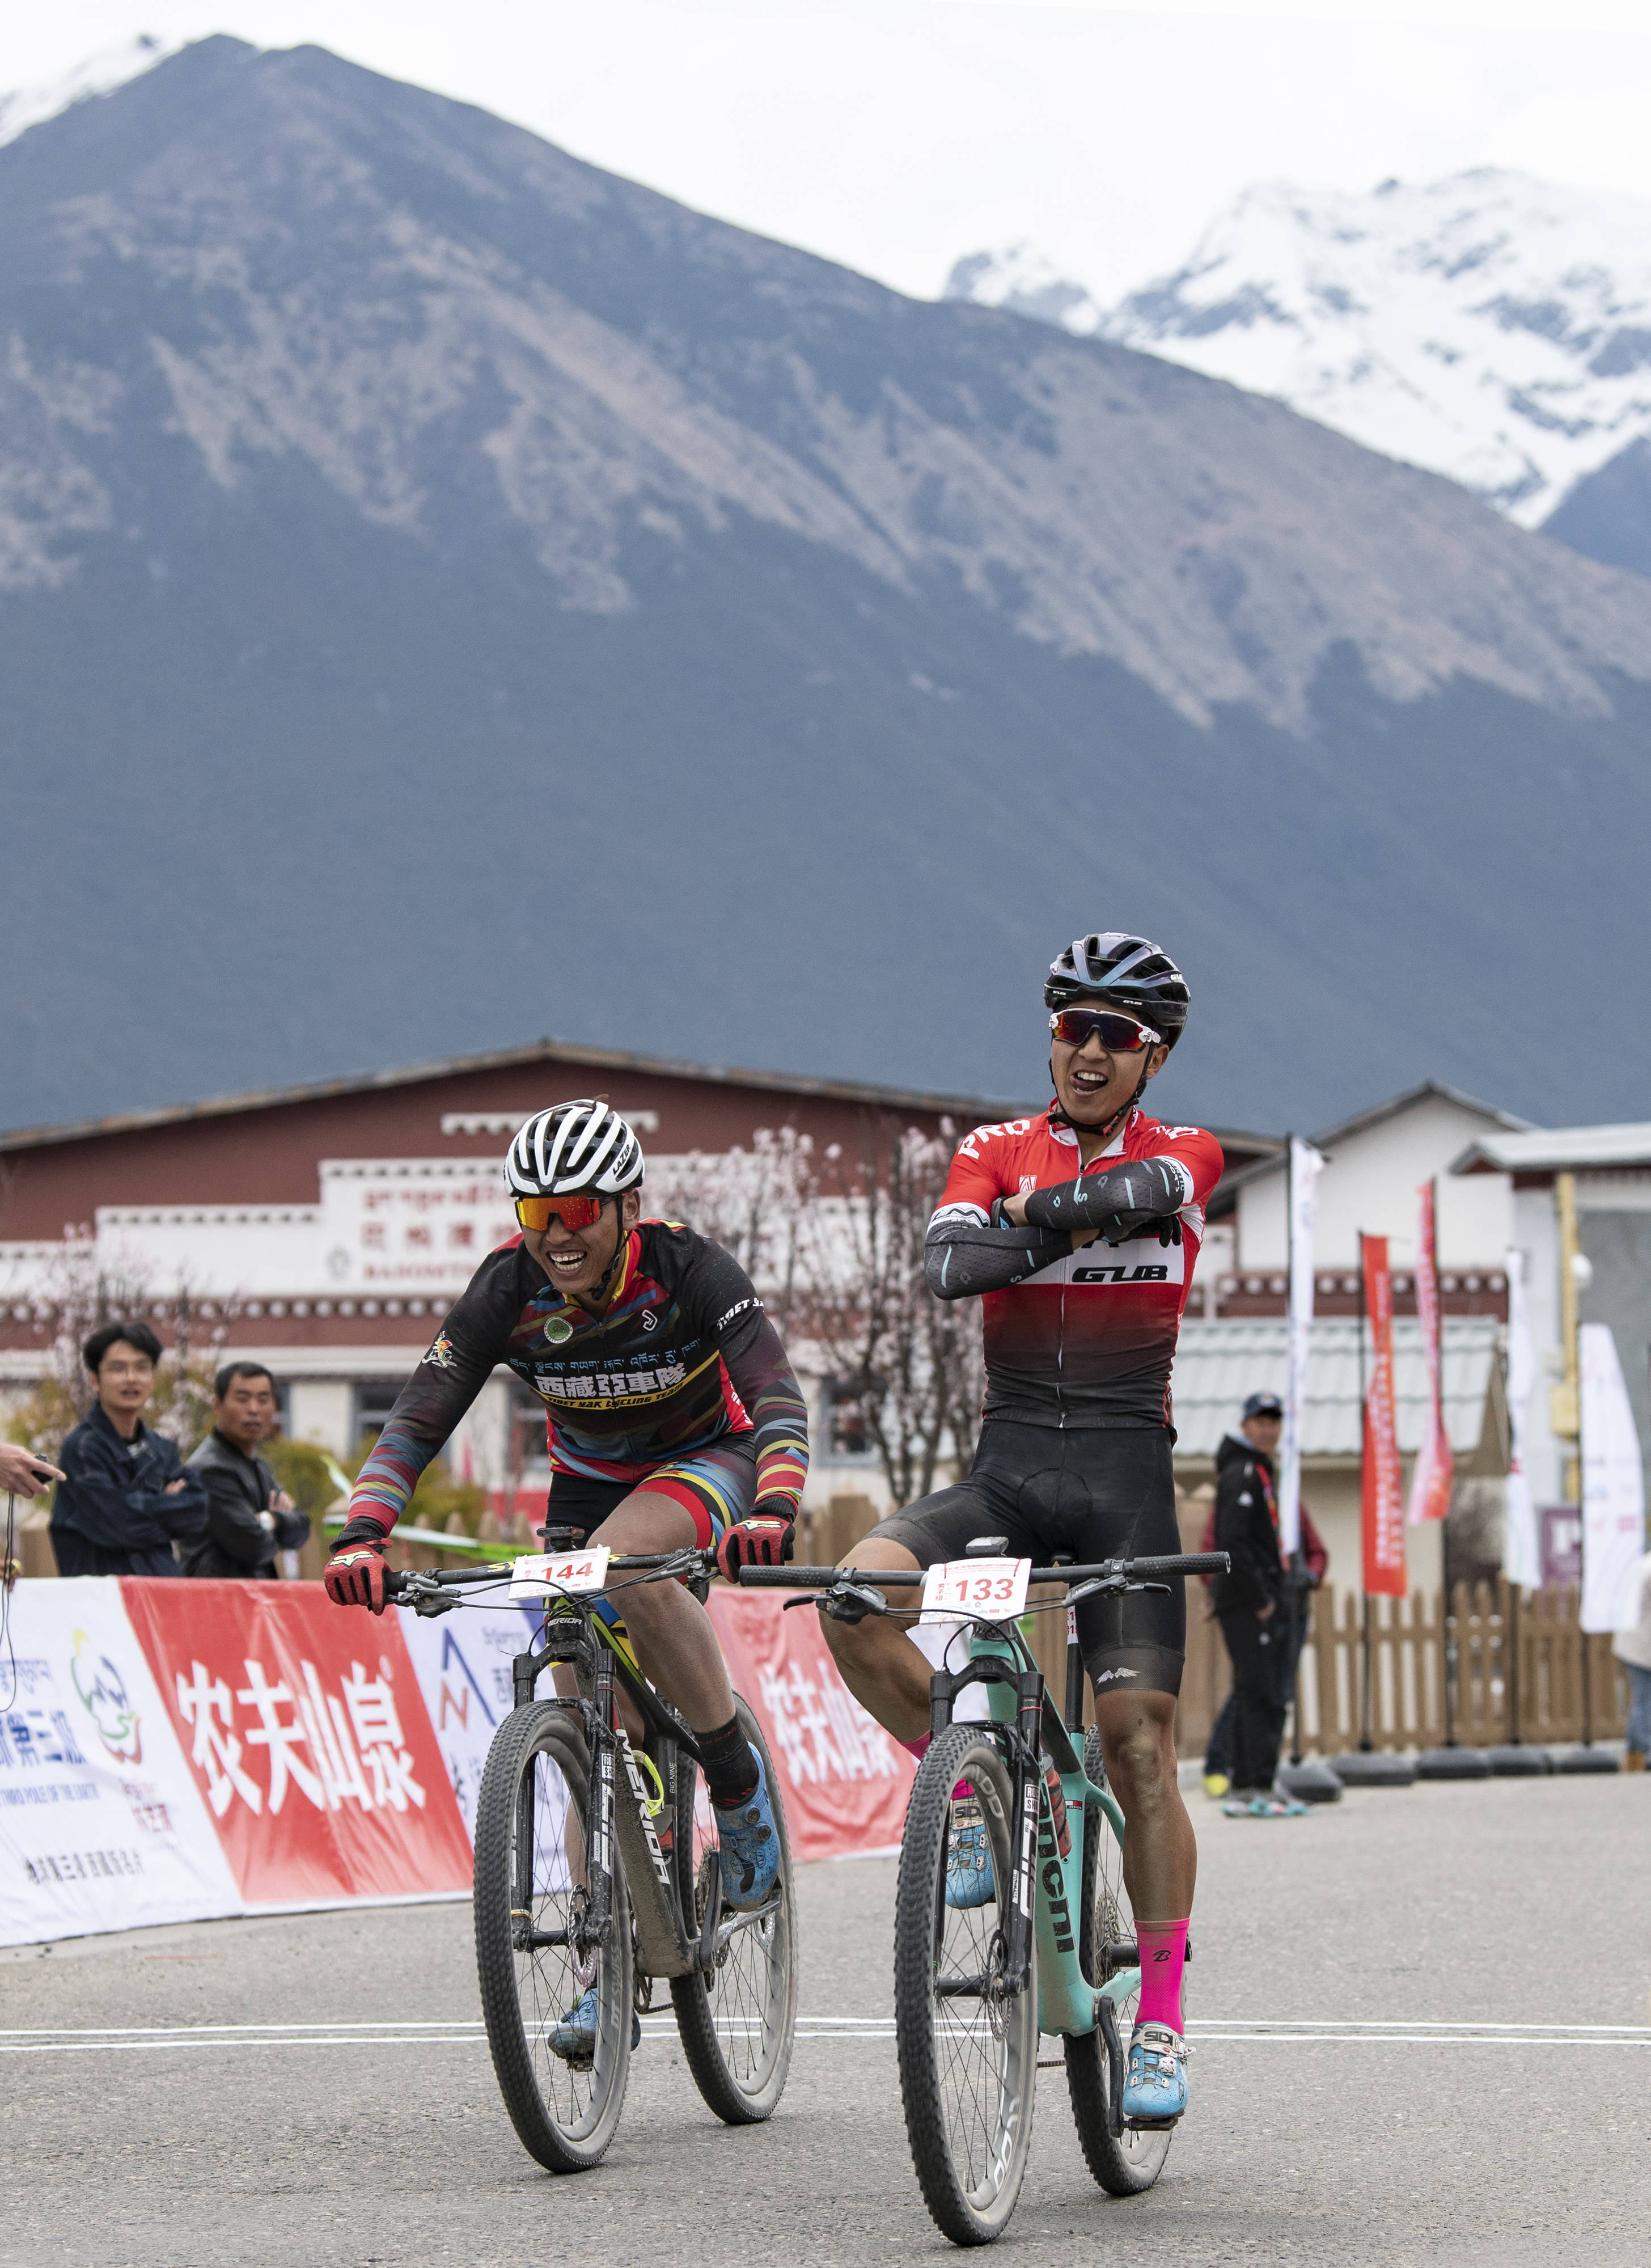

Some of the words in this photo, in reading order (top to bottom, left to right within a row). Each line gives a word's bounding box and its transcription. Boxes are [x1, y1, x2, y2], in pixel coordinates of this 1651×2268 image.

[958, 1120, 1030, 1160] PRO
[613, 1144, 631, 1176] LAZER
[1072, 1265, 1168, 1283] GUB
[547, 1397, 575, 1407] TIBET
[541, 1562, 594, 1581] 144
[955, 1579, 1014, 1601] 133
[176, 1659, 426, 1818] 农夫山泉
[616, 1729, 671, 1885] MERIDA
[1144, 2030, 1174, 2046] SIDI
